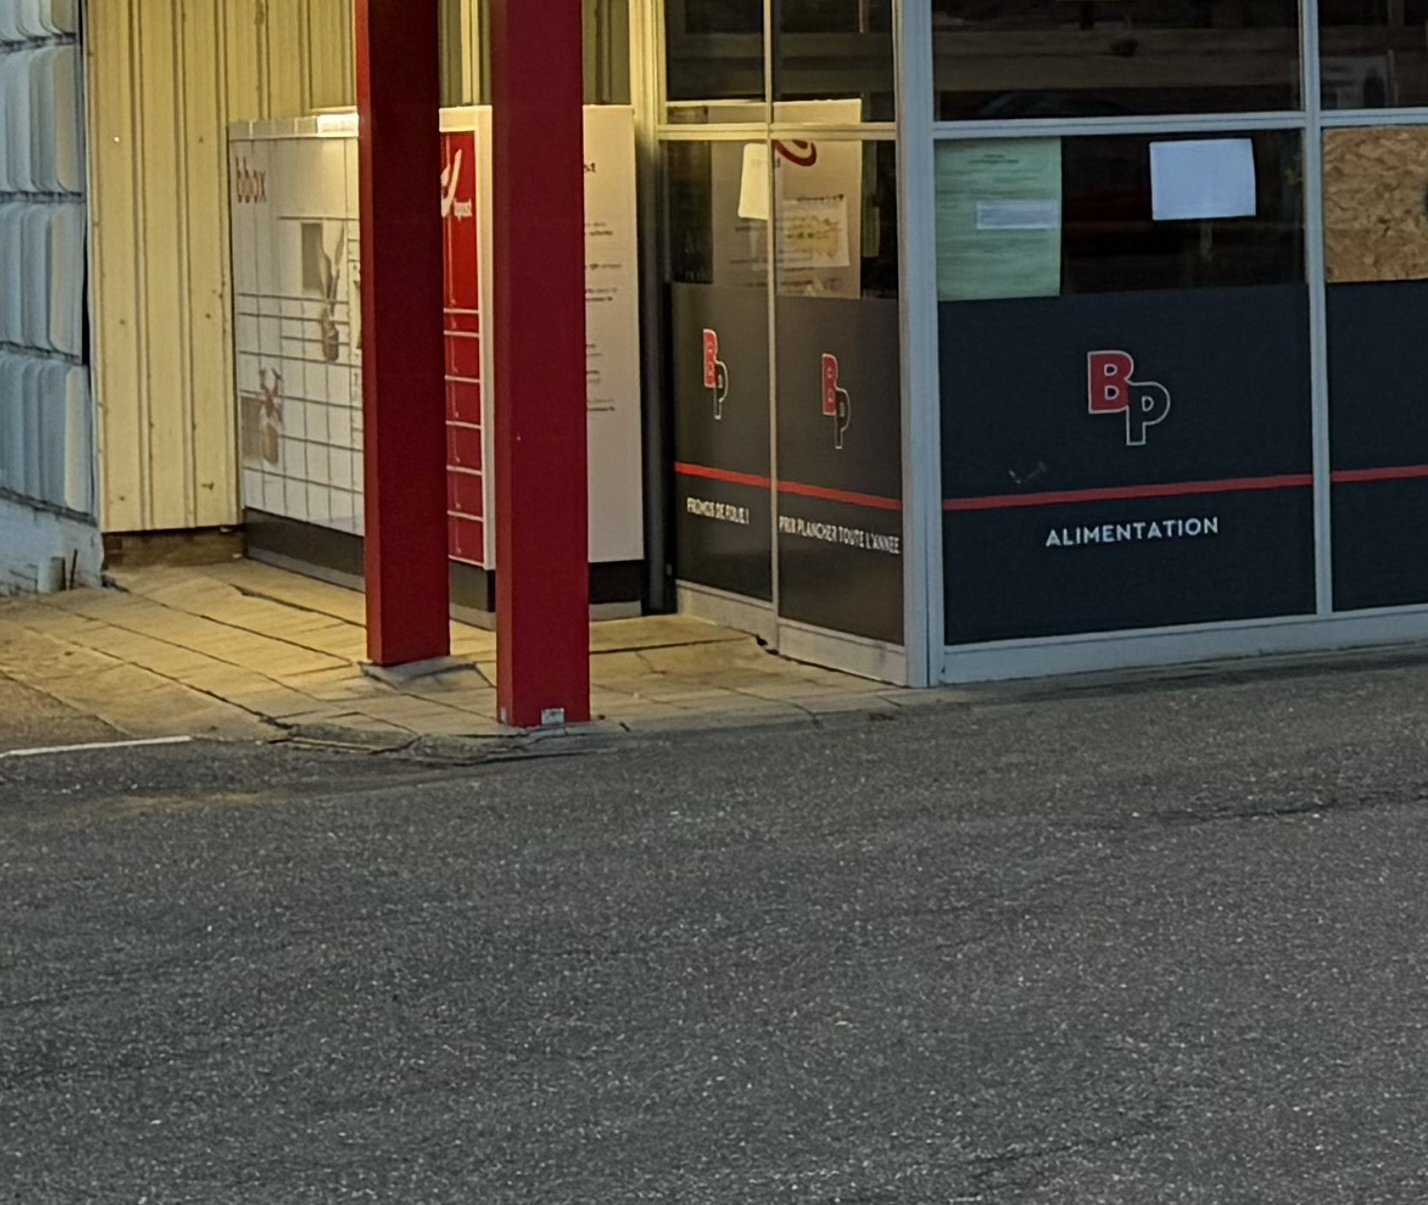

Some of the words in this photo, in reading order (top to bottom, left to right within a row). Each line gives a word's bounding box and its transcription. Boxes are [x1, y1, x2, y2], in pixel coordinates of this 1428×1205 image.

[703, 328, 729, 420] BP
[822, 353, 850, 449] BP
[1088, 350, 1171, 445] BP
[797, 518, 838, 542] PLANCHER
[839, 526, 864, 548] TOUTE
[1045, 517, 1219, 546] ALIMENTATION
